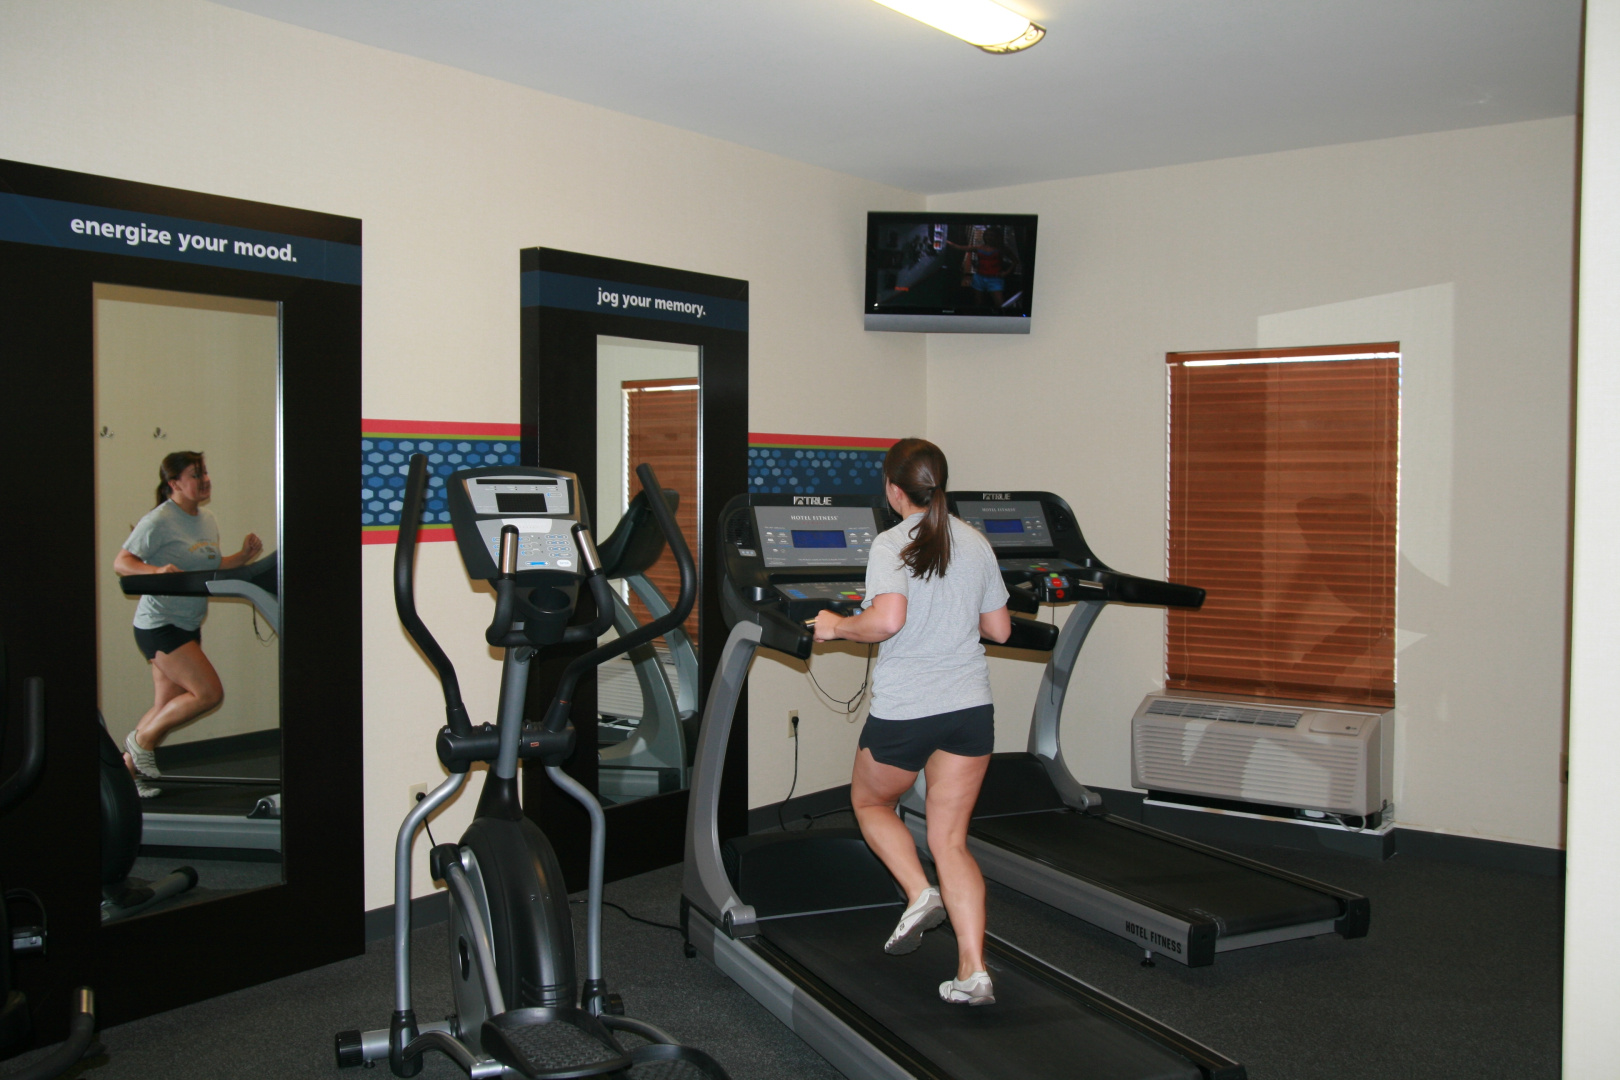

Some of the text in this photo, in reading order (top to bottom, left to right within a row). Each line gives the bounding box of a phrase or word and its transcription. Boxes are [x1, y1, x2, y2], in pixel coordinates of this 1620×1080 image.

[70, 217, 298, 262] energize your mood.
[597, 286, 706, 318] jog your memory.
[803, 496, 832, 506] TRUE
[1125, 921, 1182, 954] HOTEL FITNESS
